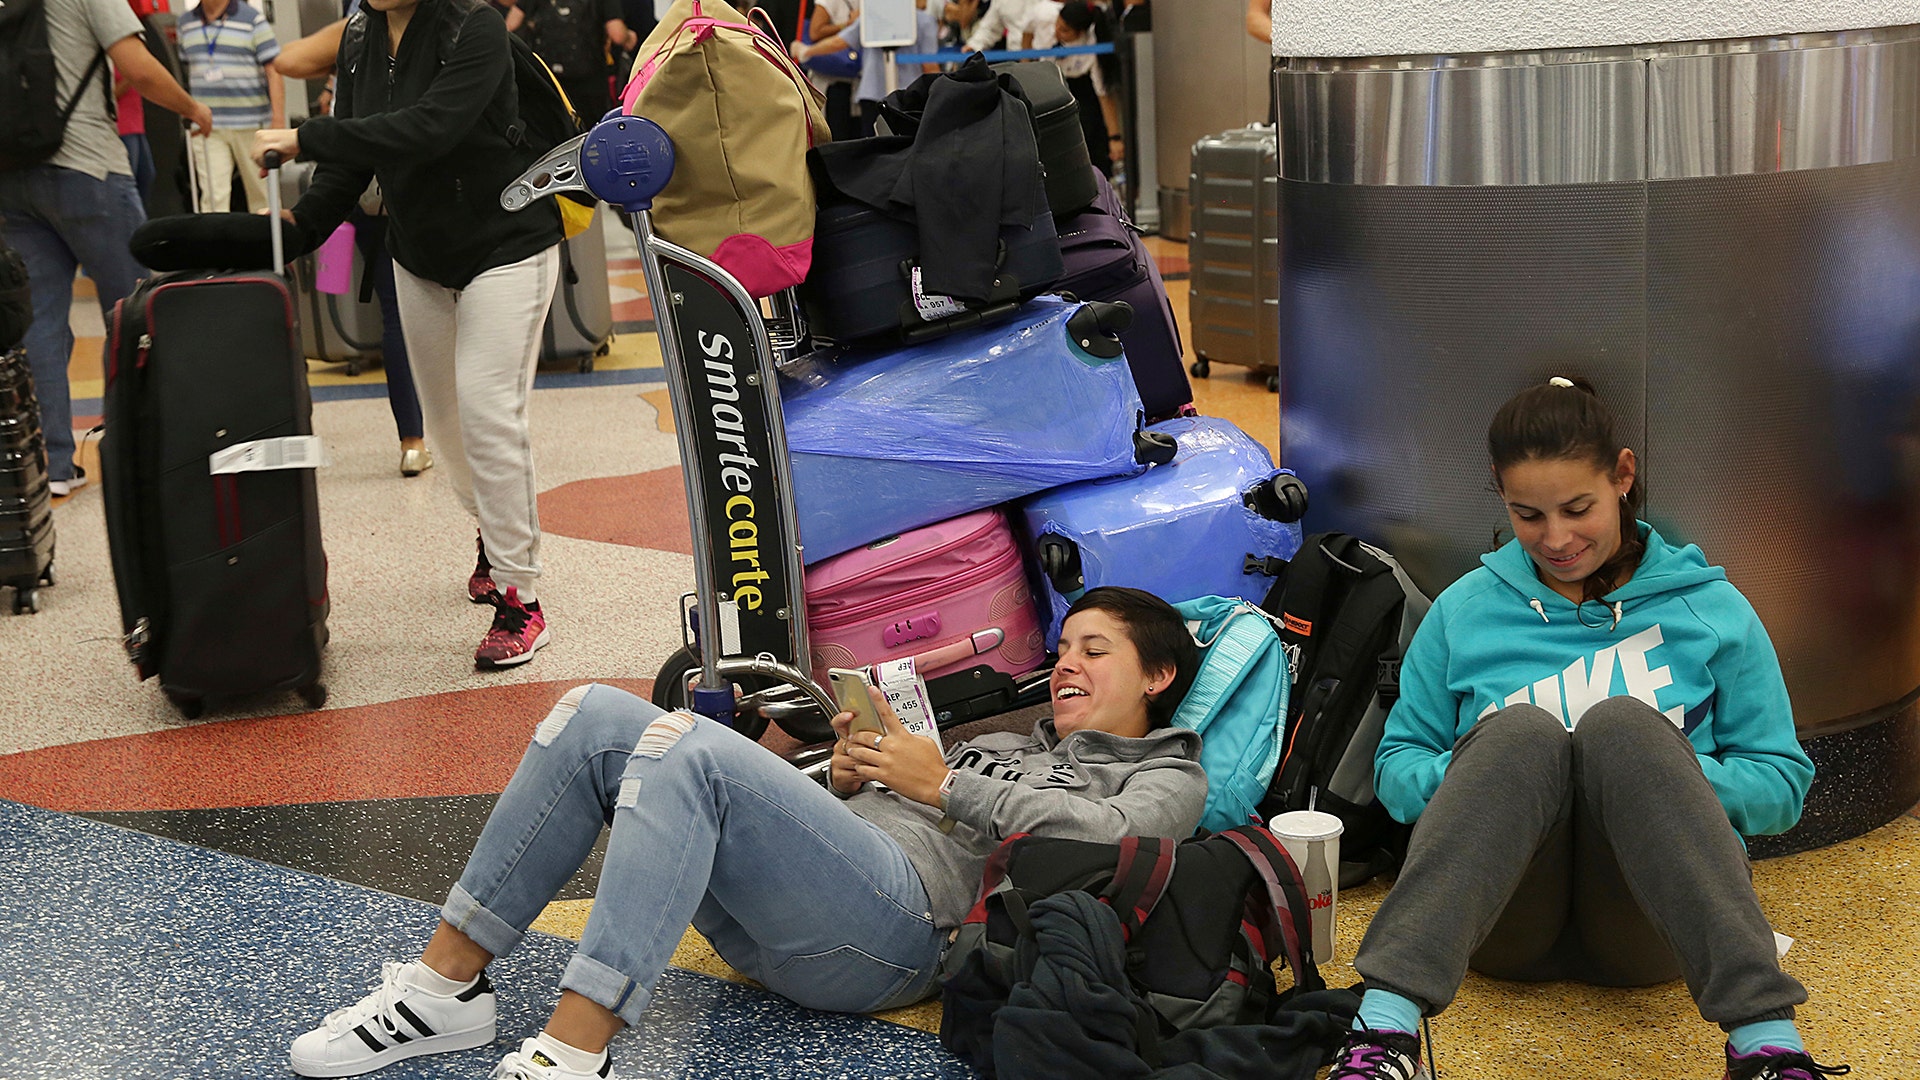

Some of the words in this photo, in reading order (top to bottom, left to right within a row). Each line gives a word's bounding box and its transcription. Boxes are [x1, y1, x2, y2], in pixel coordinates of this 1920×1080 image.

[1477, 623, 1684, 732] IKE
[902, 700, 918, 711] 455
[898, 717, 910, 725] CL
[909, 721, 925, 733] 957
[1309, 893, 1332, 910] oke
